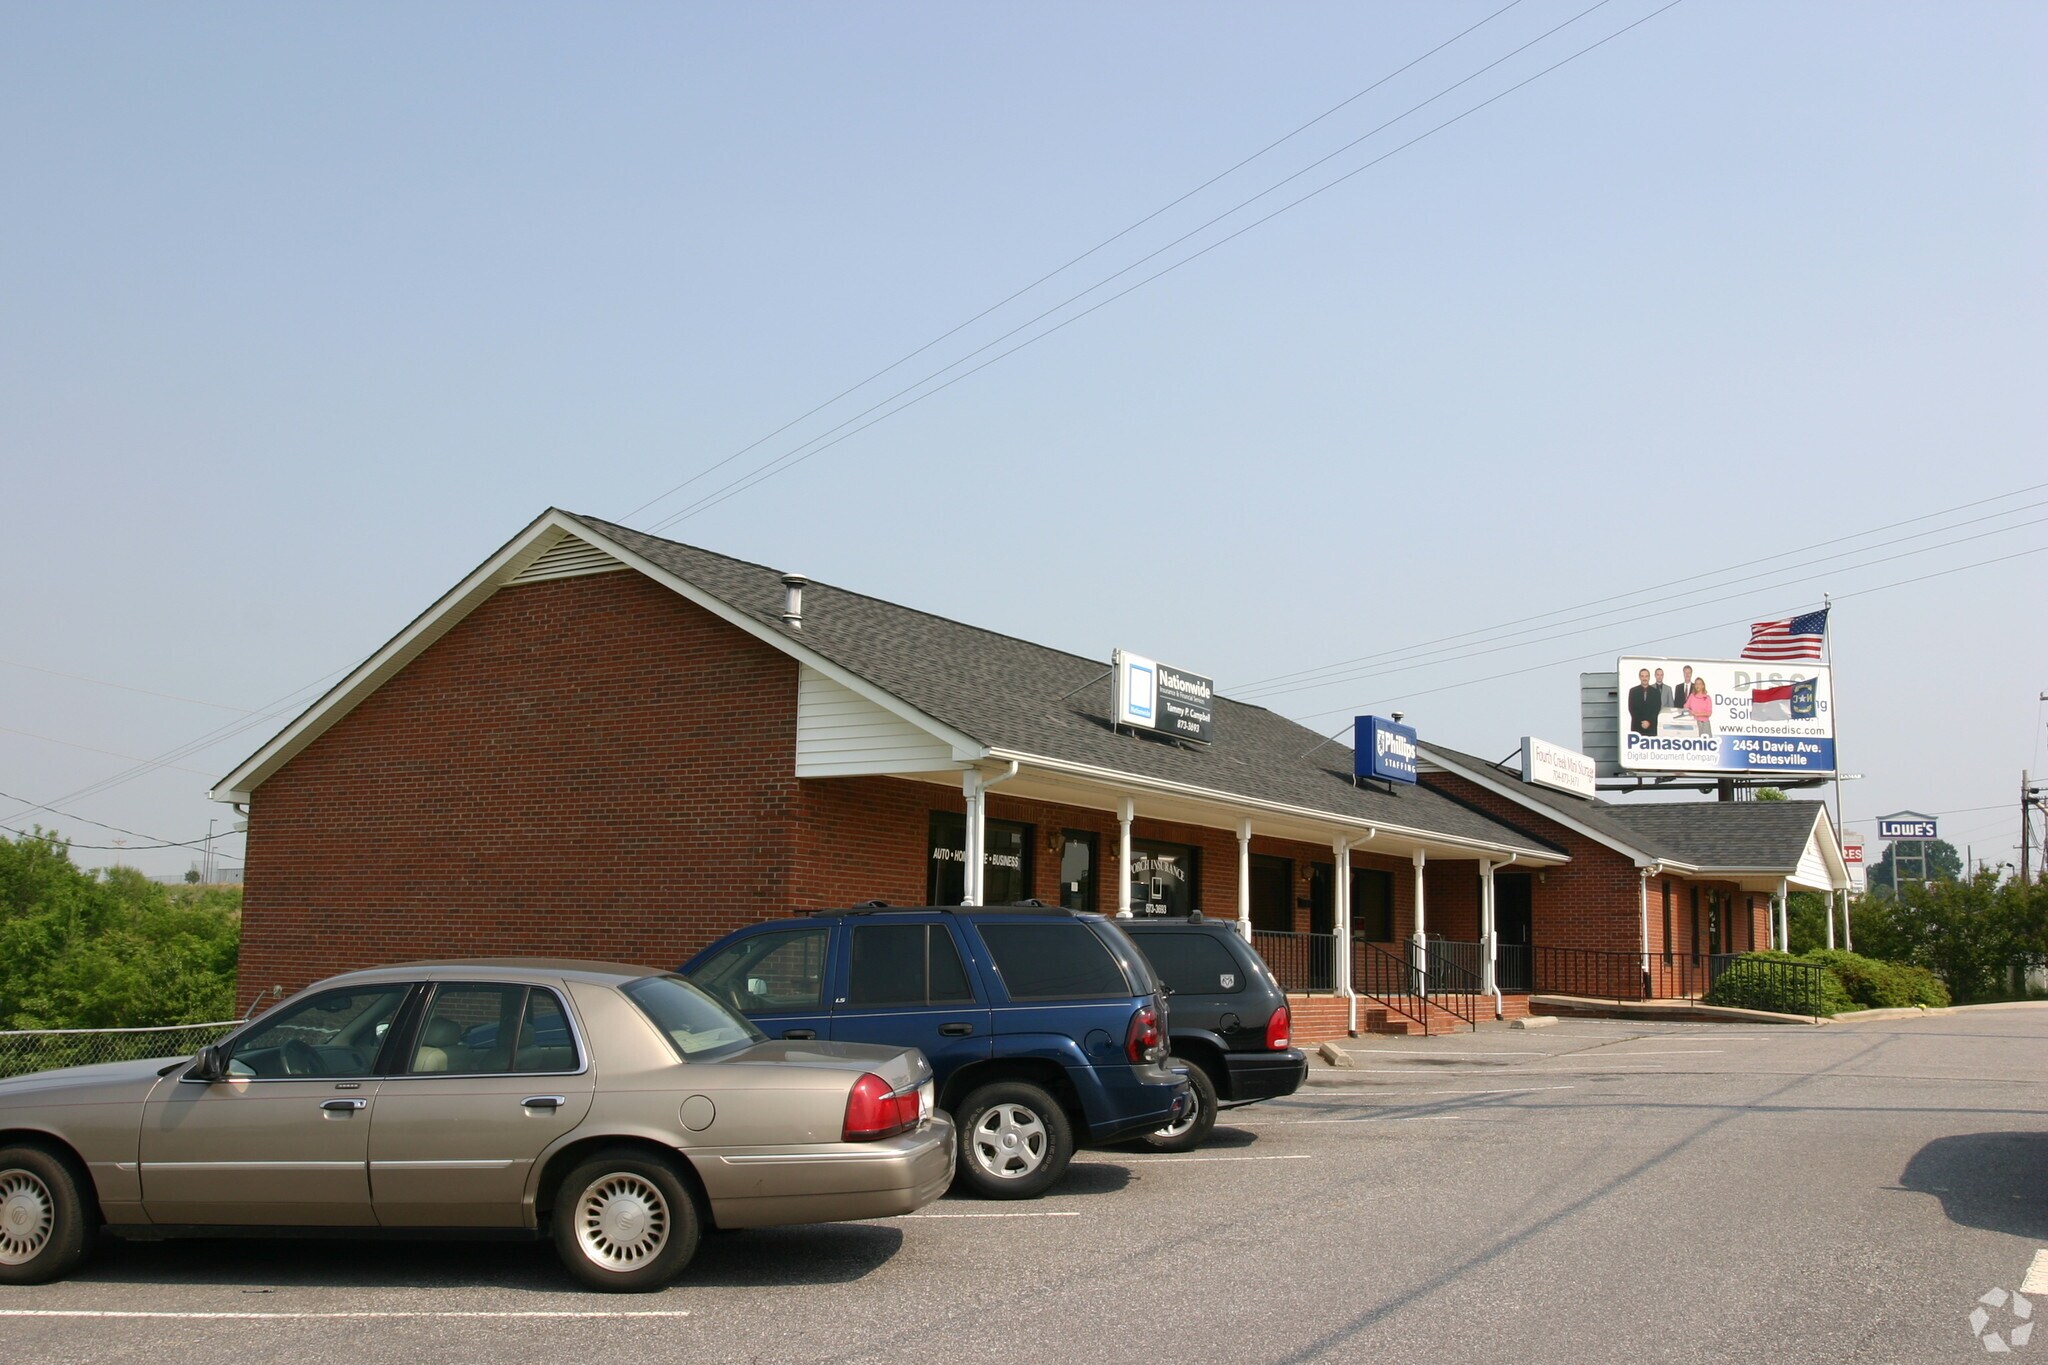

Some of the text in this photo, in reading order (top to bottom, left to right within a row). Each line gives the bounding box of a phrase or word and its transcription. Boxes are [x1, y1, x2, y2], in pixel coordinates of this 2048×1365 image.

[1159, 669, 1210, 699] Nationwide
[1166, 702, 1210, 723] Tammy P. Campbell
[1177, 719, 1200, 733] 873-3693
[1719, 725, 1825, 736] www.choosedisc.com
[1385, 731, 1416, 763] Phillips
[1627, 733, 1718, 752] Panasonic
[1732, 740, 1822, 754] 2454 Davie Ave.
[1535, 746, 1553, 765] Fourth
[1553, 752, 1567, 770] Creek
[1578, 760, 1594, 783] Storage
[1627, 751, 1719, 763] Digital Document Company
[1748, 753, 1808, 765] Statesville
[1384, 758, 1416, 774] STAFFING
[1882, 822, 1935, 836] LOWE'S
[932, 847, 950, 861] AUTO
[992, 853, 1020, 867] BUSINESS
[1130, 859, 1185, 882] ORCH INSURANCE
